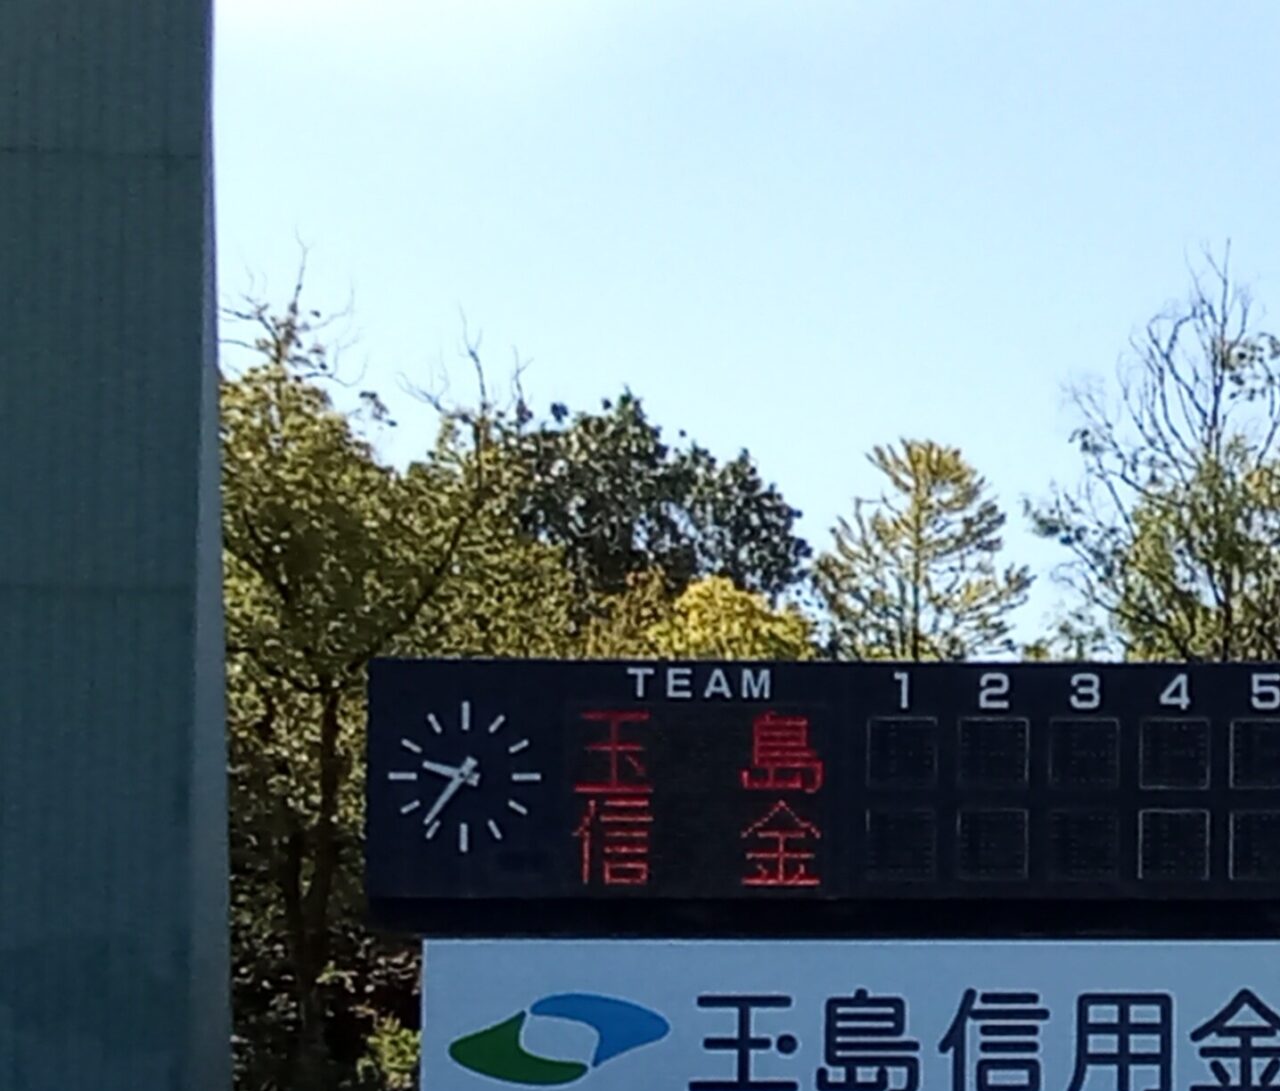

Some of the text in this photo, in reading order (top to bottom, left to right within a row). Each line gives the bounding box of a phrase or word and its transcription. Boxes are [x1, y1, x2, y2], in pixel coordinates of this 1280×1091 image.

[627, 667, 771, 699] TEAM
[893, 672, 909, 709] 1
[979, 672, 1009, 709] 2
[1070, 672, 1100, 709] 3
[1159, 673, 1190, 710] 4
[1251, 673, 1280, 709] 5
